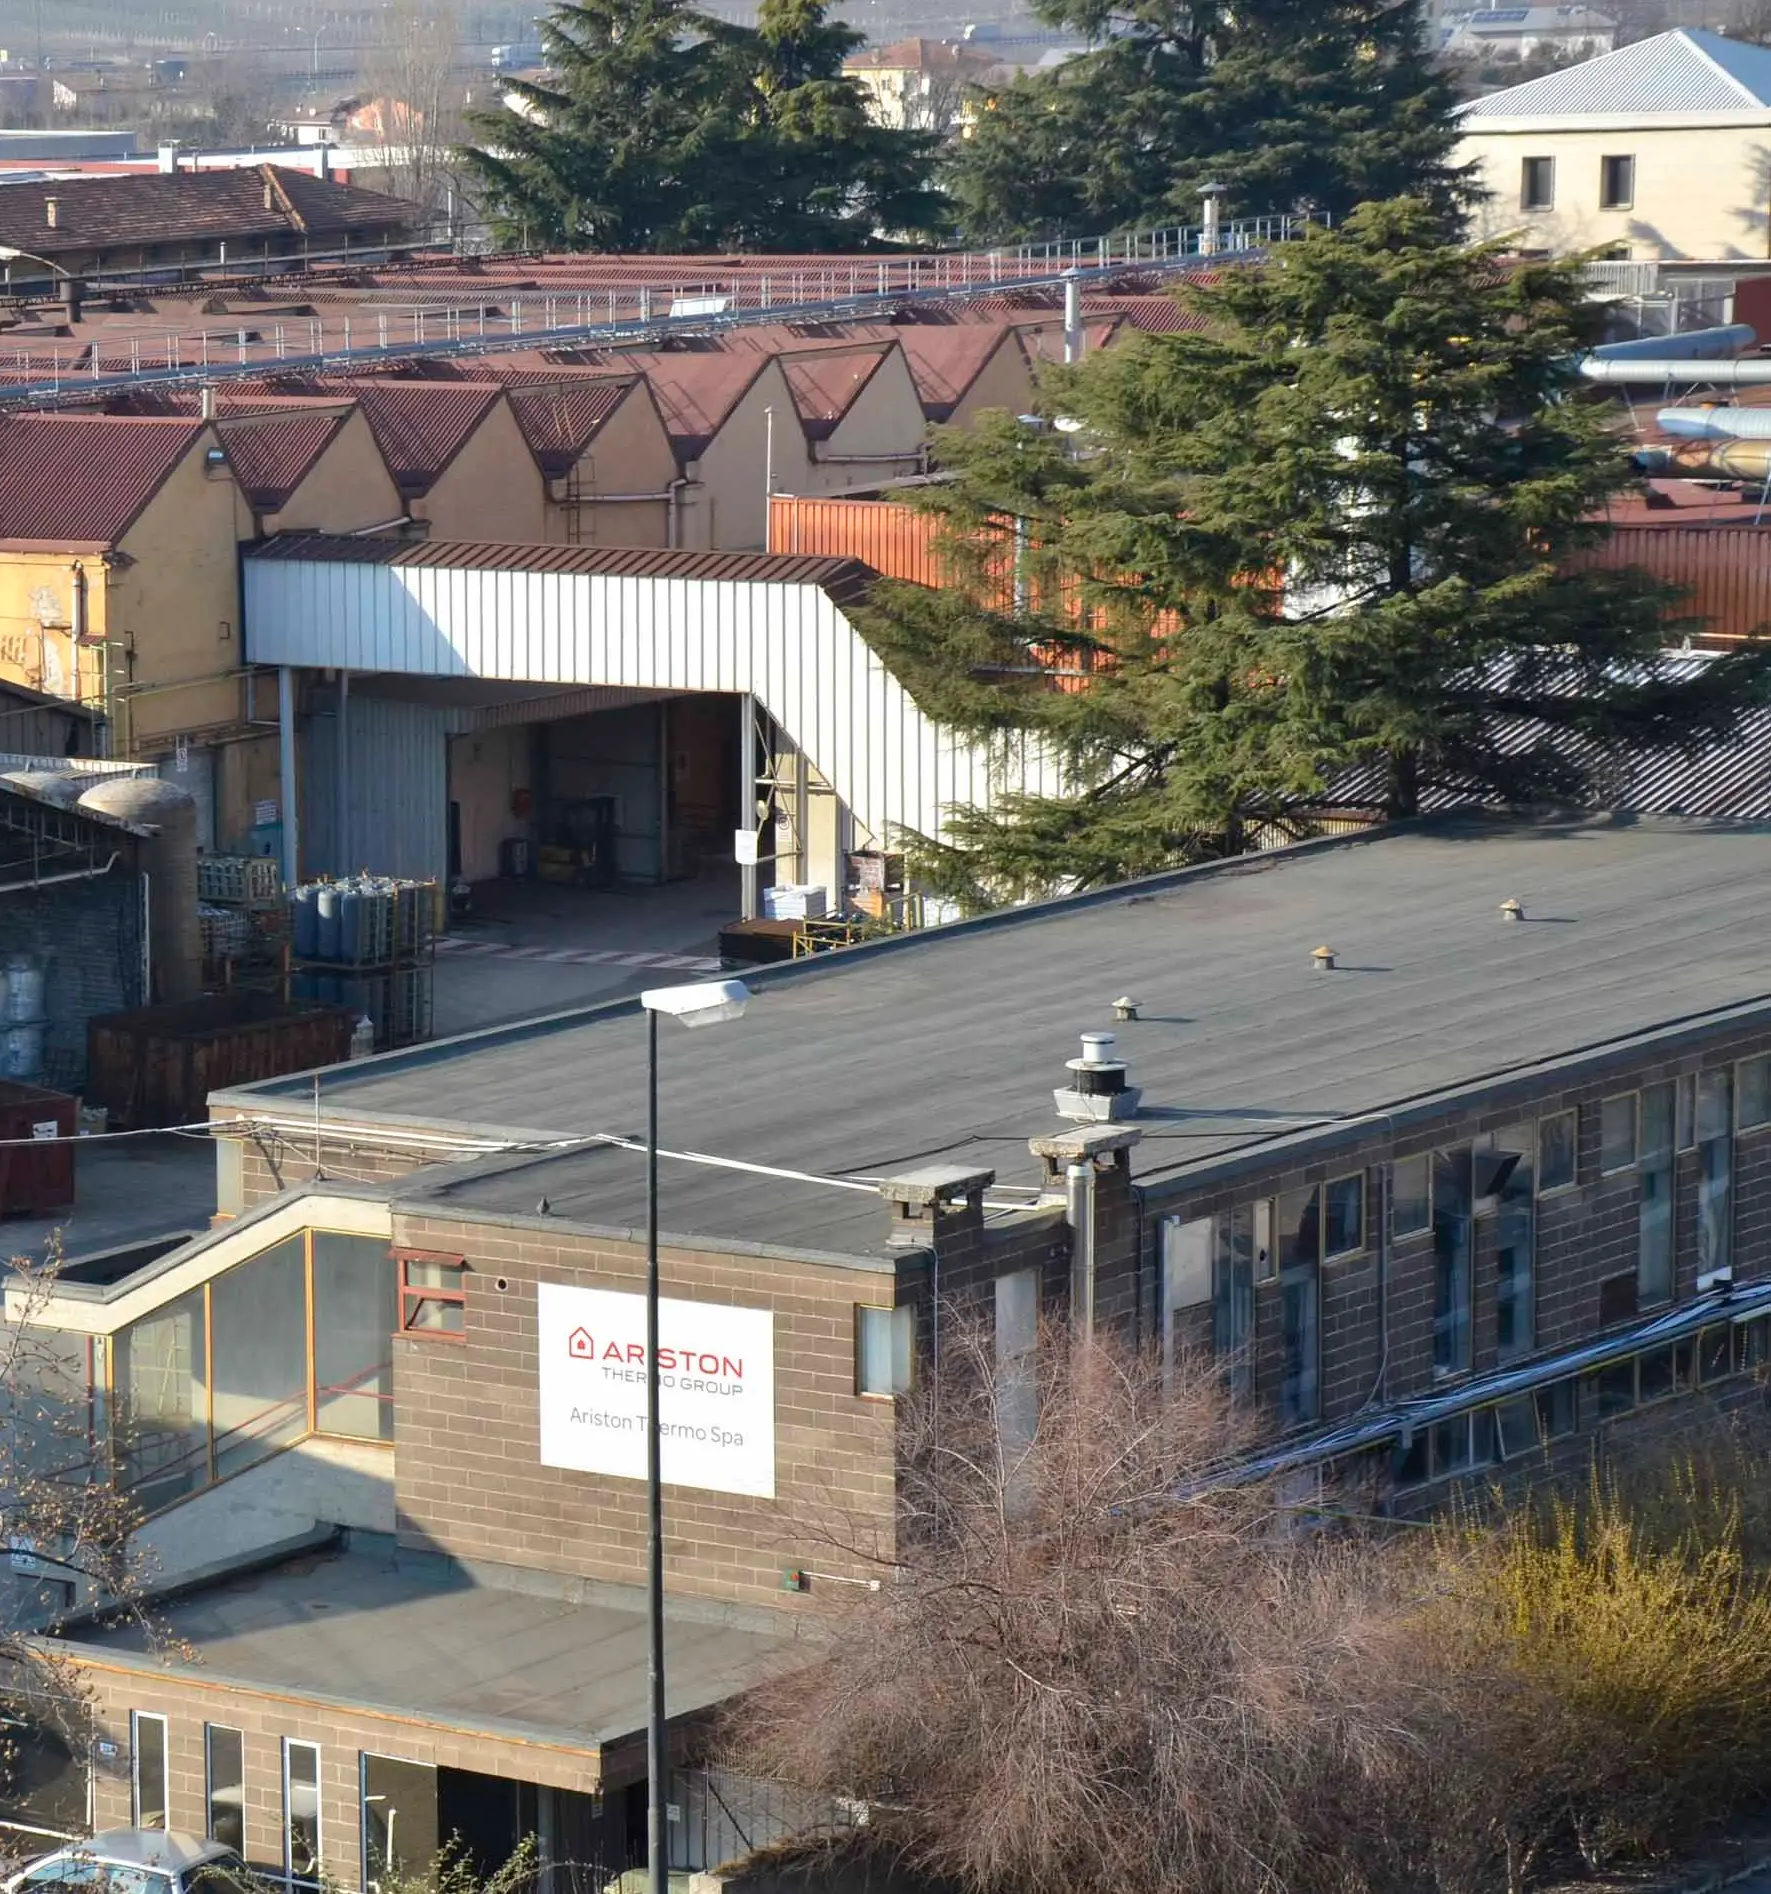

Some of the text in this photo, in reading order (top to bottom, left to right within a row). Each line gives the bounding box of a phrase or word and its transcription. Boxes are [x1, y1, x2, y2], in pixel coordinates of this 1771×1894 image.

[602, 1341, 743, 1378] ARSTON
[601, 1366, 743, 1396] THERO GROUP
[570, 1406, 743, 1447] Ariston Termo Spa
